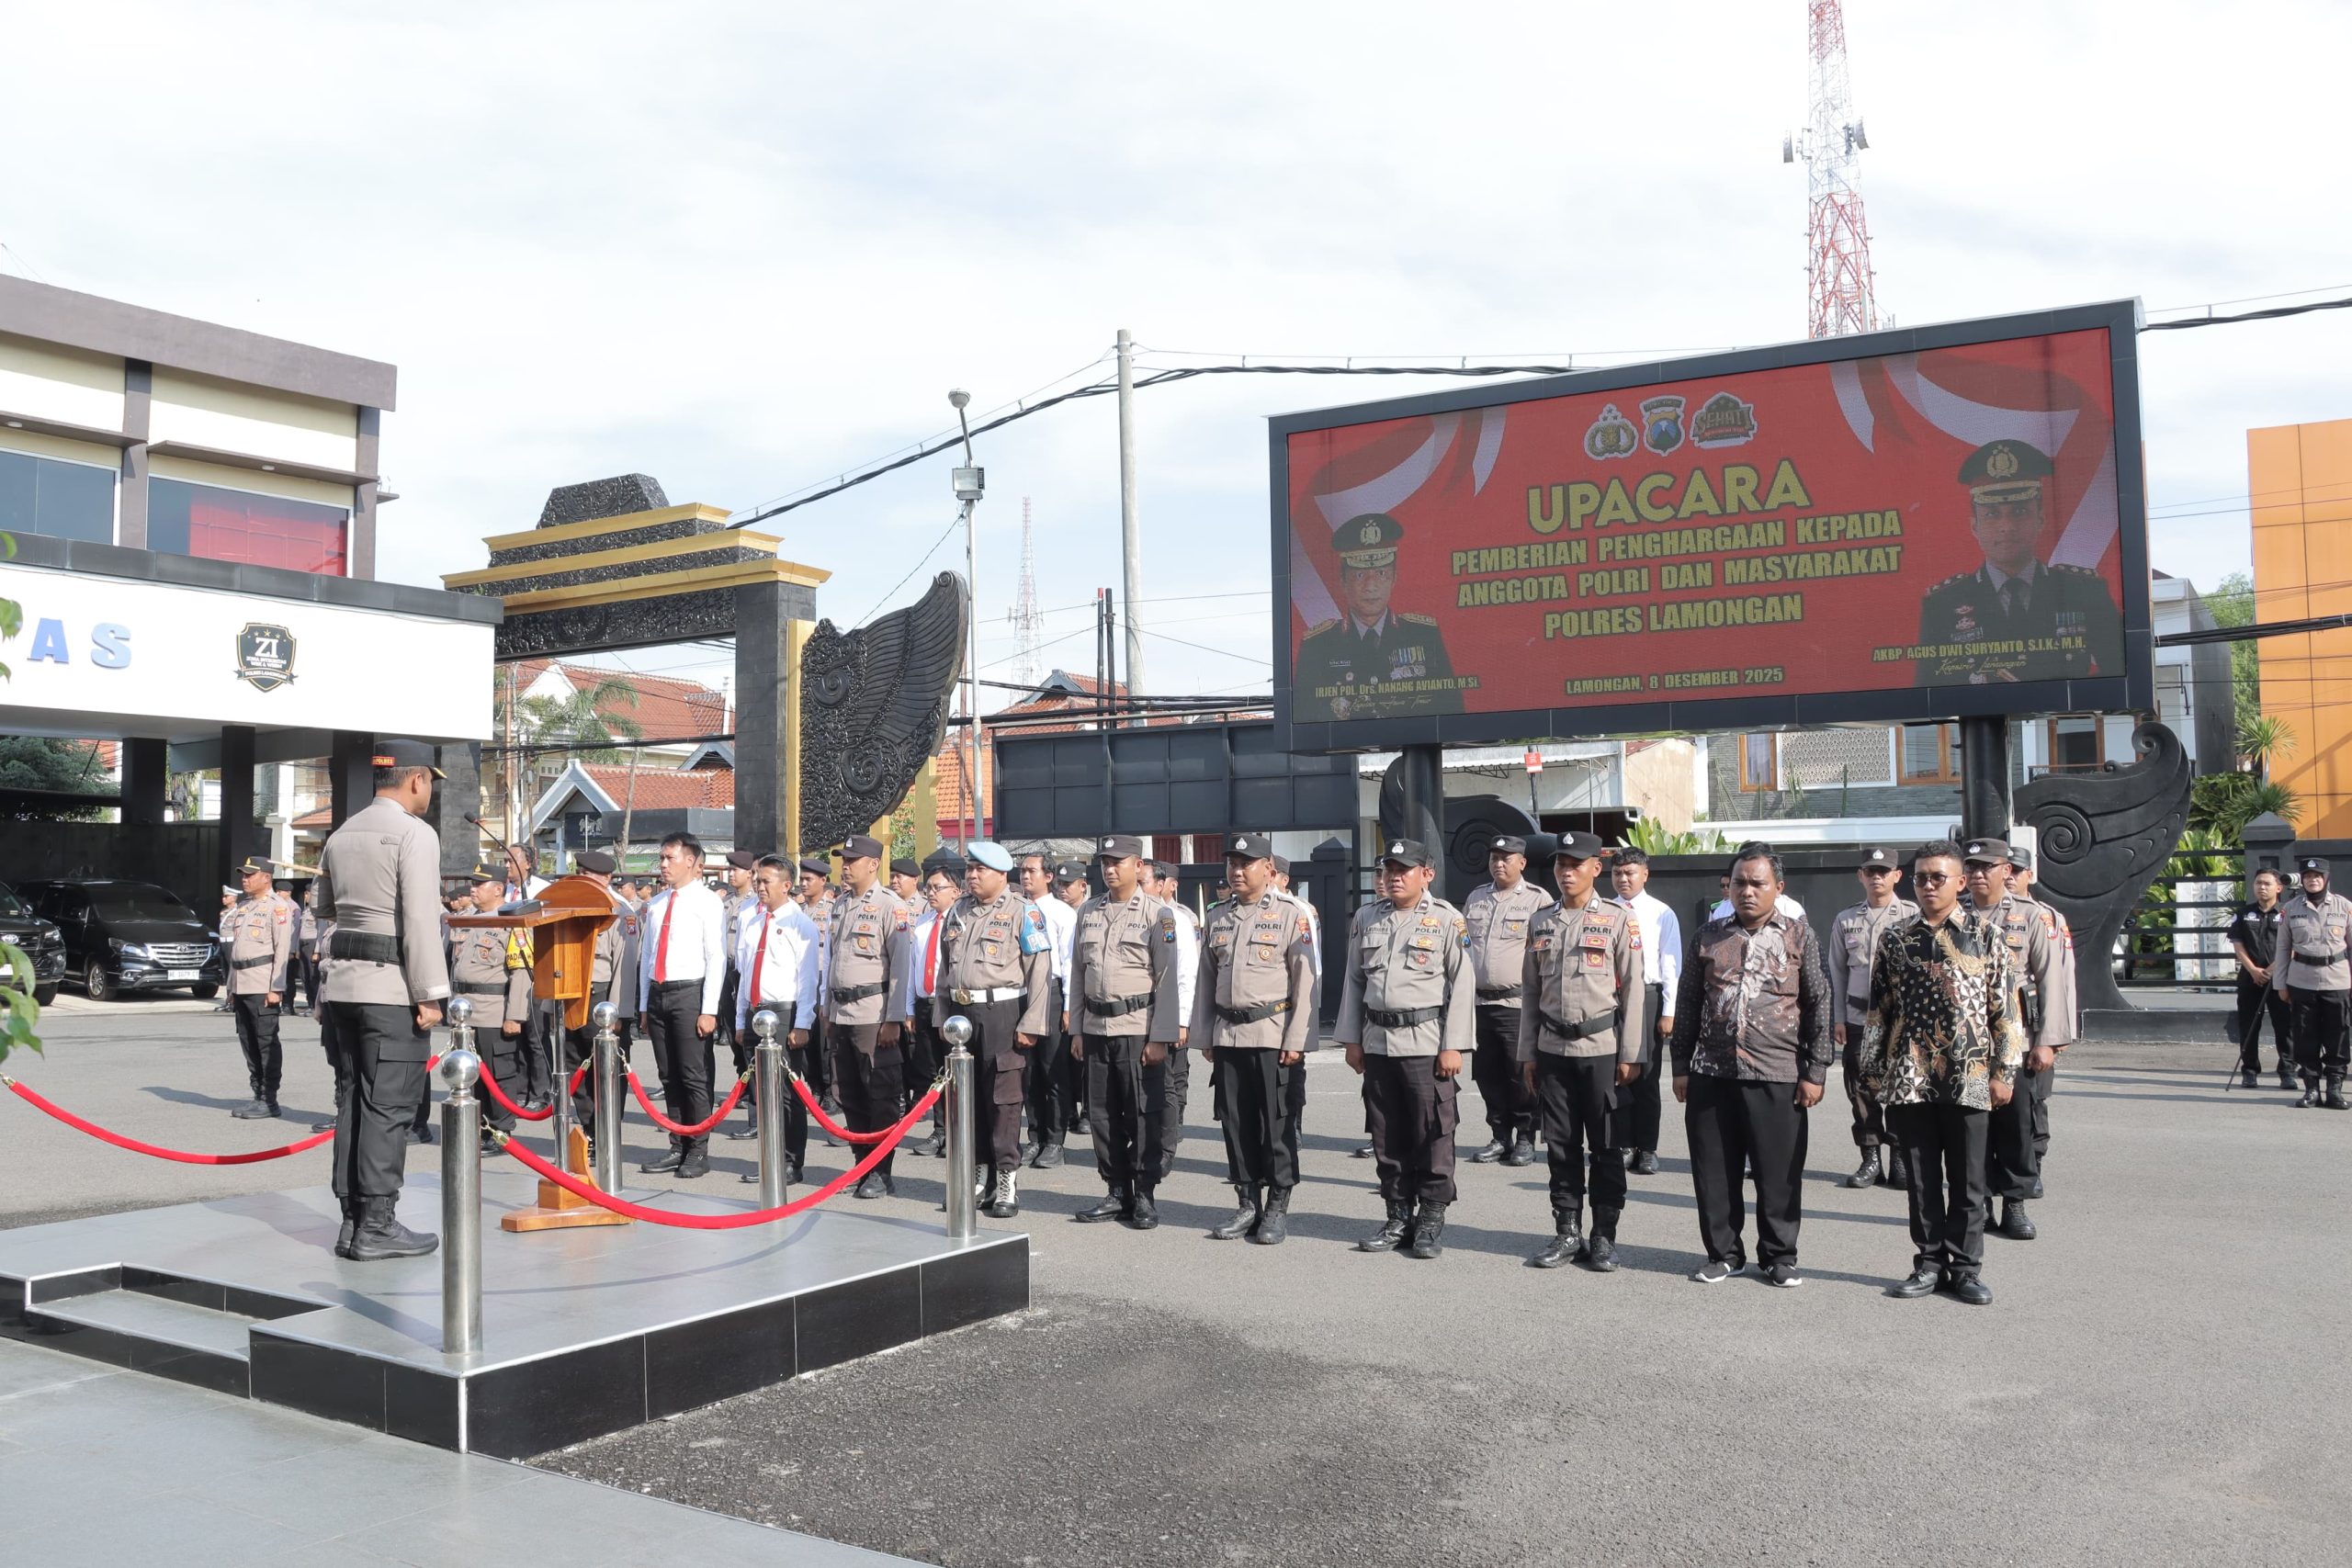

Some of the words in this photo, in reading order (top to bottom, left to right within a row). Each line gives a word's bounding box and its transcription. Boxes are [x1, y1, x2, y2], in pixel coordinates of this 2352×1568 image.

[1528, 461, 1809, 532] UPACARA
[1453, 540, 1587, 574] PEMBERIAN
[1599, 521, 1784, 561] PENGHARGAAN
[1797, 511, 1902, 543] KEPADA
[1458, 576, 1567, 607] ANGGOTA
[1578, 568, 1649, 597] POLRI
[1661, 563, 1713, 591] DAN
[1724, 546, 1902, 585] MASYARAKAT
[1545, 605, 1642, 638] POLRES
[1649, 594, 1802, 632] LAMONGAN
[254, 637, 279, 659] ZI
[1873, 648, 1902, 661] AKBP
[1907, 646, 1936, 659] AGUS
[1939, 644, 1962, 657] DWI
[2062, 636, 2086, 649] M.H.
[1316, 686, 1338, 698] IRJEN
[1360, 684, 1376, 695] Drs.
[1378, 682, 1414, 694] NANANG
[1566, 675, 1644, 695] LAMONGAN,
[1649, 674, 1658, 689] 8
[1665, 669, 1738, 688] DESEMBER
[1745, 666, 1783, 685] 2025
[1583, 926, 1611, 935] POLRI
